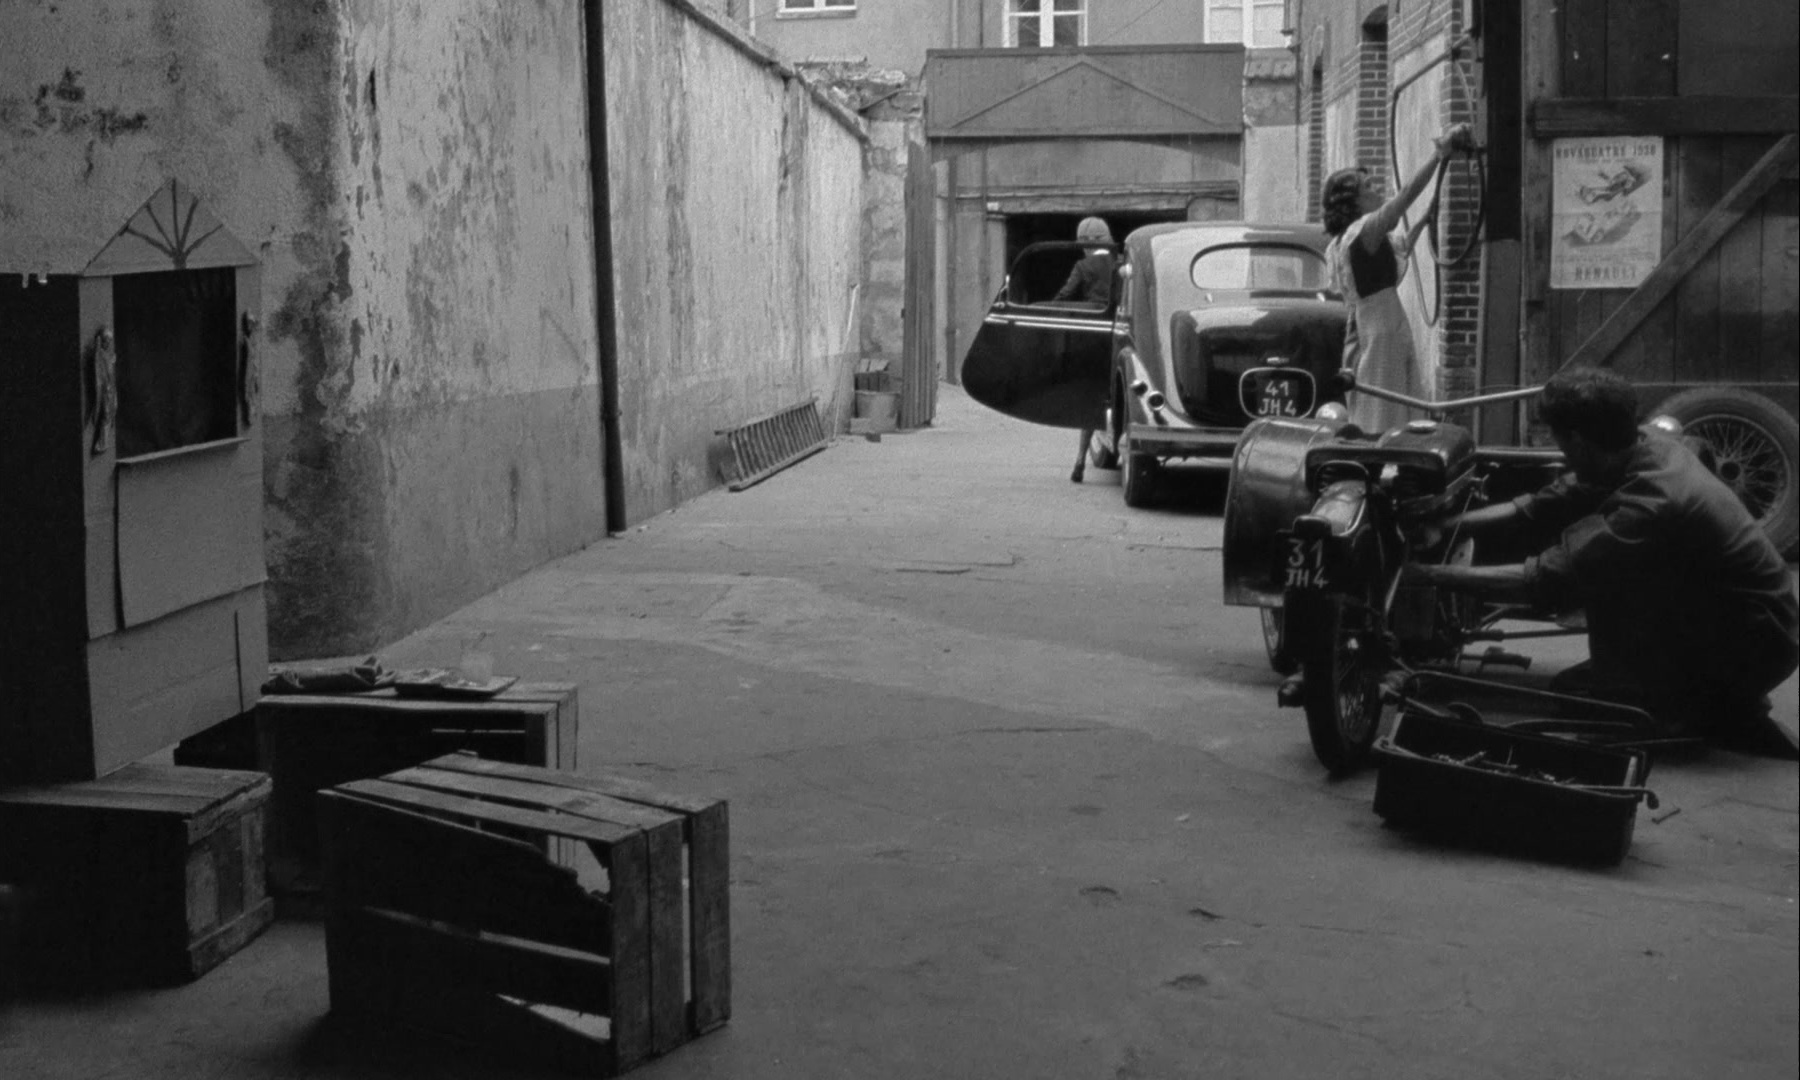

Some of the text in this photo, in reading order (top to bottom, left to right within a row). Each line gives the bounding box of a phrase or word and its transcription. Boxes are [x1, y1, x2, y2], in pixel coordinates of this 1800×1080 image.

[1574, 267, 1636, 281] RENAULT
[1265, 380, 1289, 396] 41
[1258, 398, 1297, 416] JH 4
[1288, 538, 1323, 569] 31
[1285, 566, 1329, 588] JH 4
